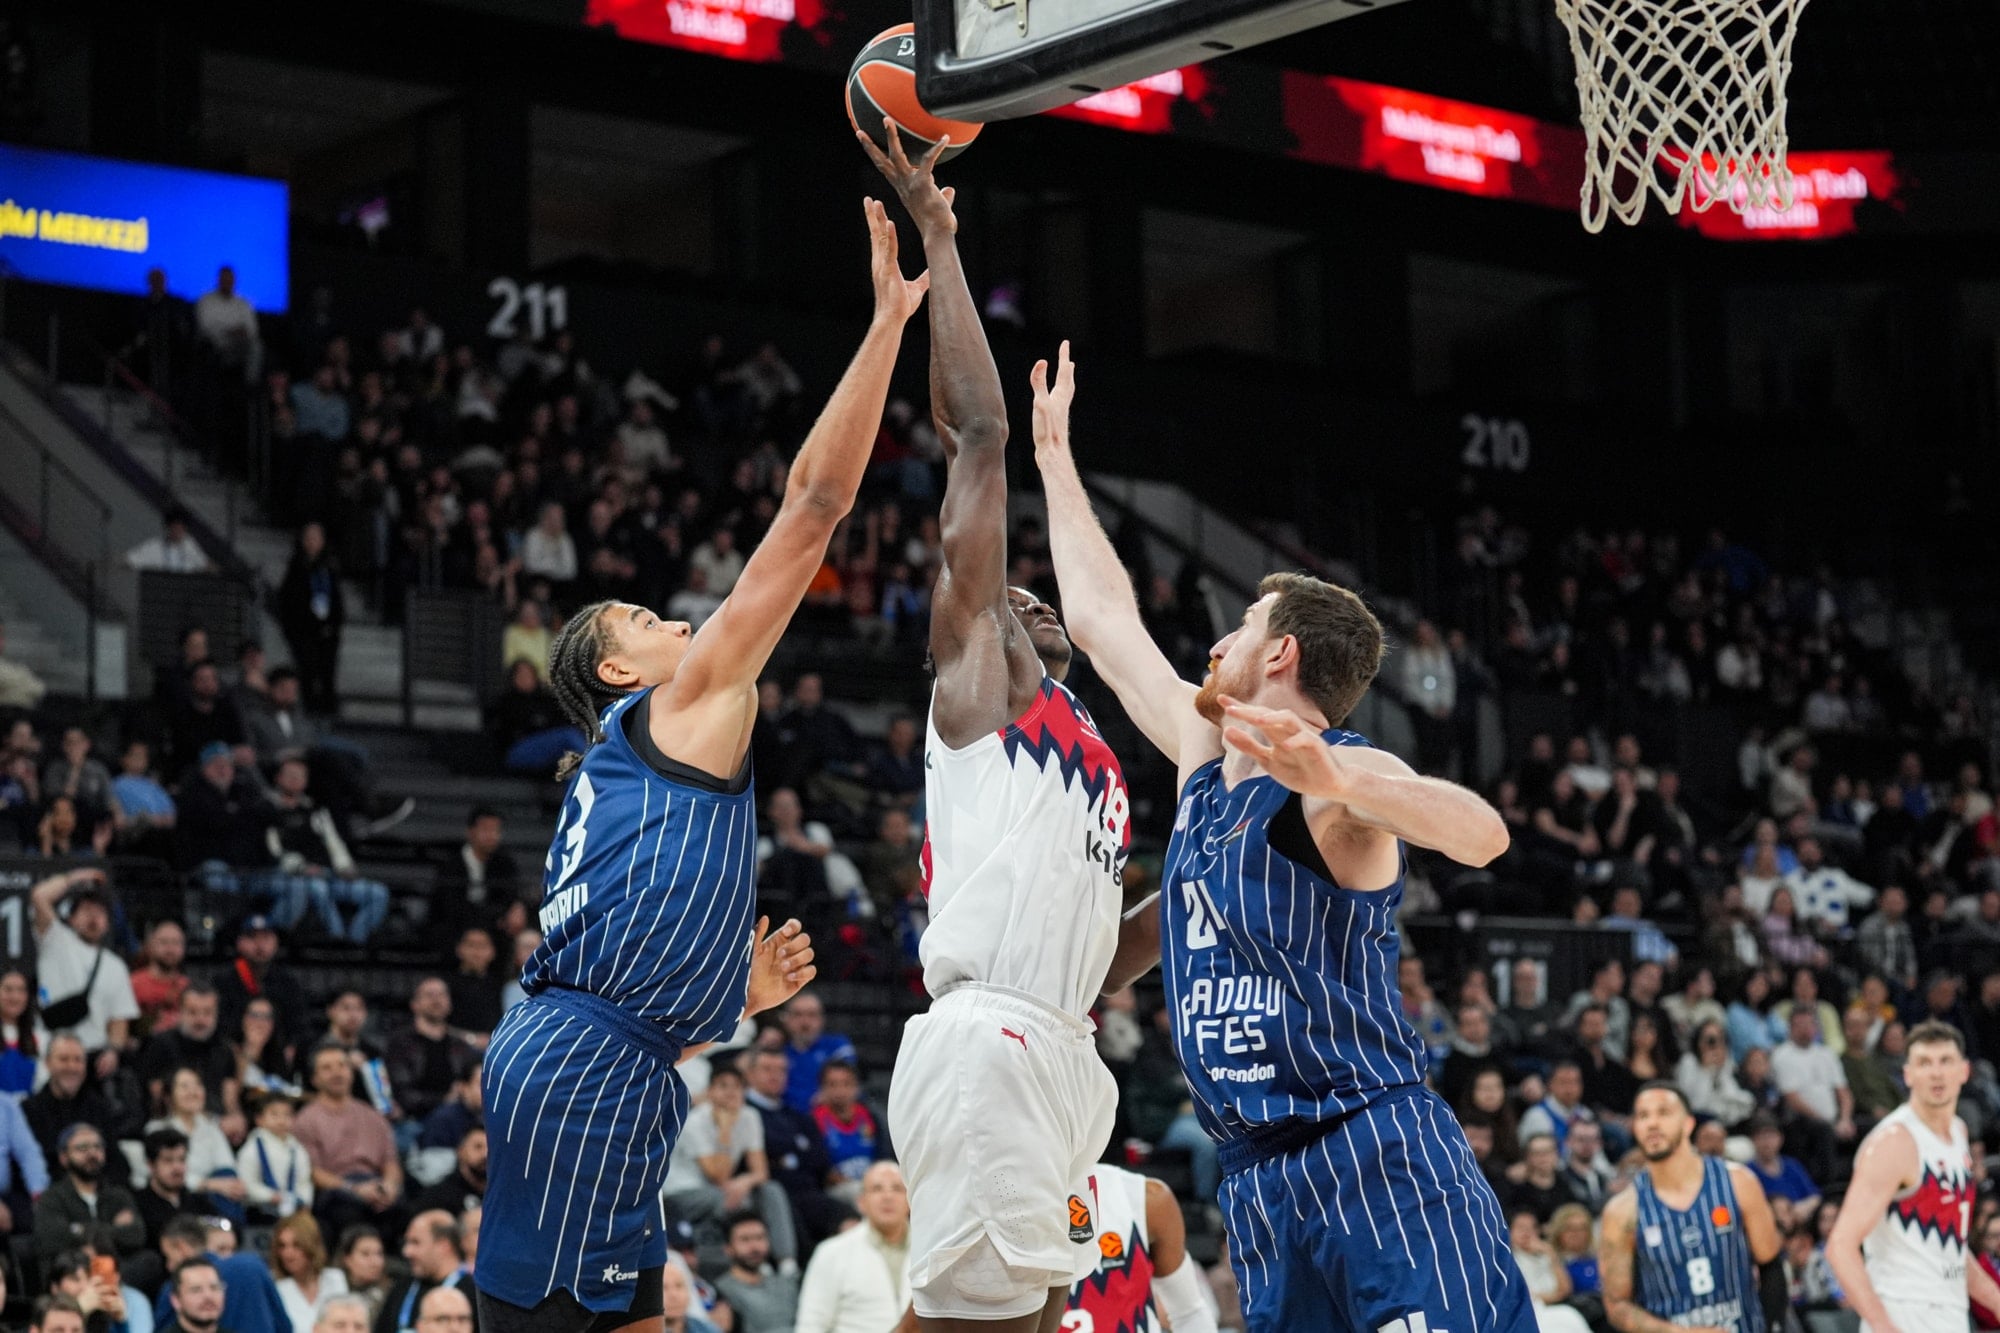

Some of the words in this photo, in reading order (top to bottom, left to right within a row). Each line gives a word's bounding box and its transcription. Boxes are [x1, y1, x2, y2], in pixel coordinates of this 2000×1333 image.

[486, 277, 567, 341] 211
[1461, 414, 1529, 471] 210
[1686, 1256, 1714, 1296] 8
